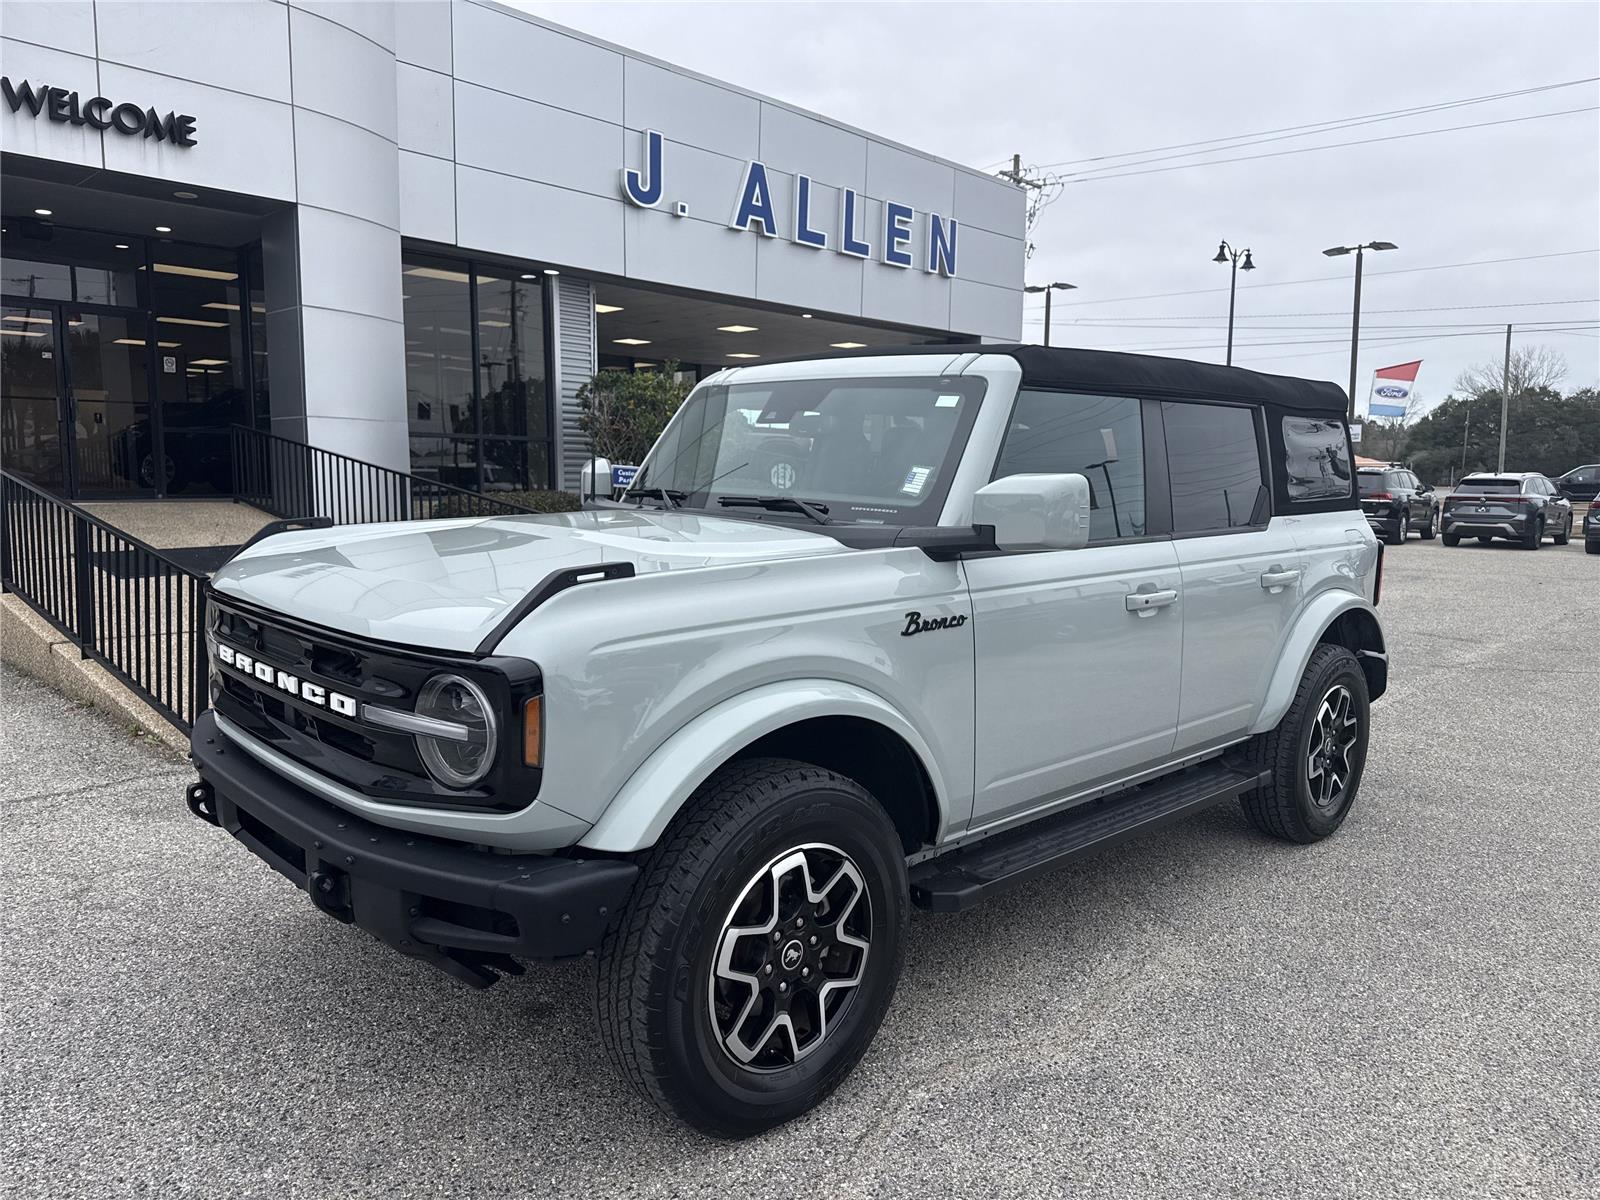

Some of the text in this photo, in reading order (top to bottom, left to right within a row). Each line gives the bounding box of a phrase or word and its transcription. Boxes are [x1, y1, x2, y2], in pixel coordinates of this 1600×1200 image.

[0, 76, 197, 147] WELCOME
[620, 128, 959, 277] J. ALLEN
[900, 611, 968, 636] Bronco
[219, 643, 357, 717] BRONCO
